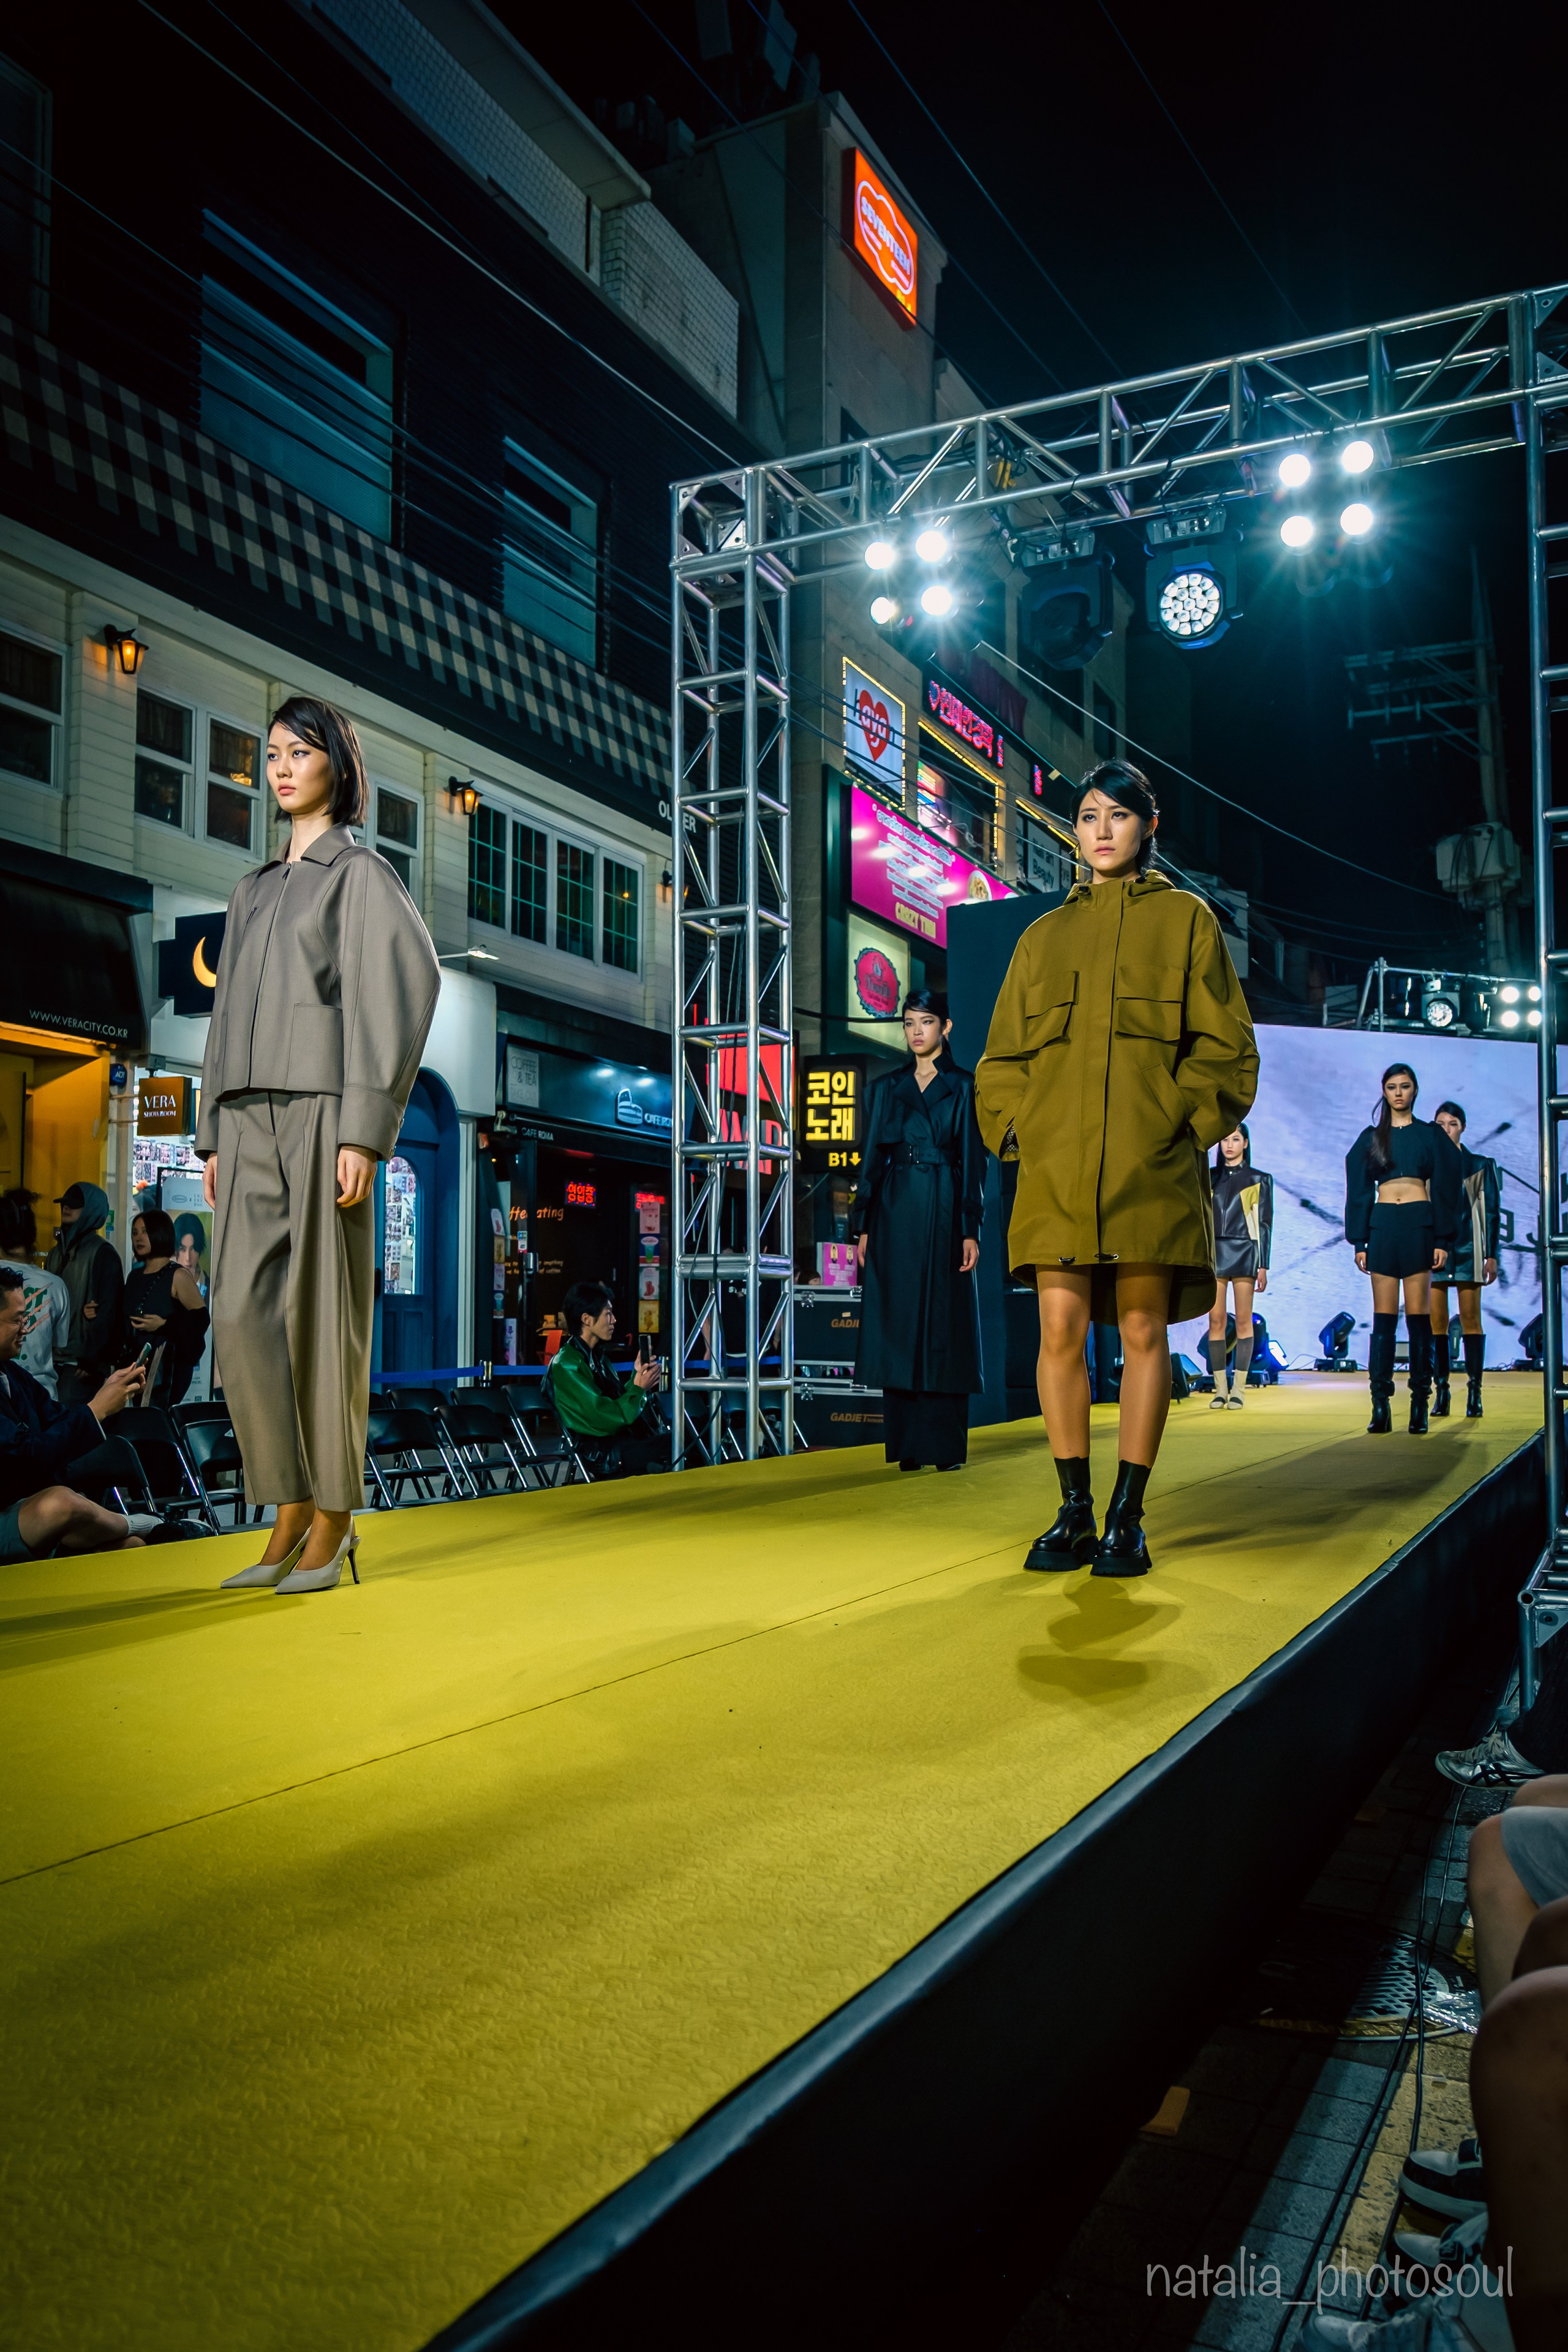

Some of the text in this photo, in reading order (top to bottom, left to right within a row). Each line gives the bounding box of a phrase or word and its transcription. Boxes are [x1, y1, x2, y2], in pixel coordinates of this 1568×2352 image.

[29, 1009, 128, 1039] WWW.VERACITY.CO.KR
[807, 1071, 855, 1105] 코인
[144, 1095, 176, 1109] VERA
[806, 1107, 854, 1140] 노래
[829, 1152, 847, 1167] B1
[567, 1183, 594, 1204] 영업중
